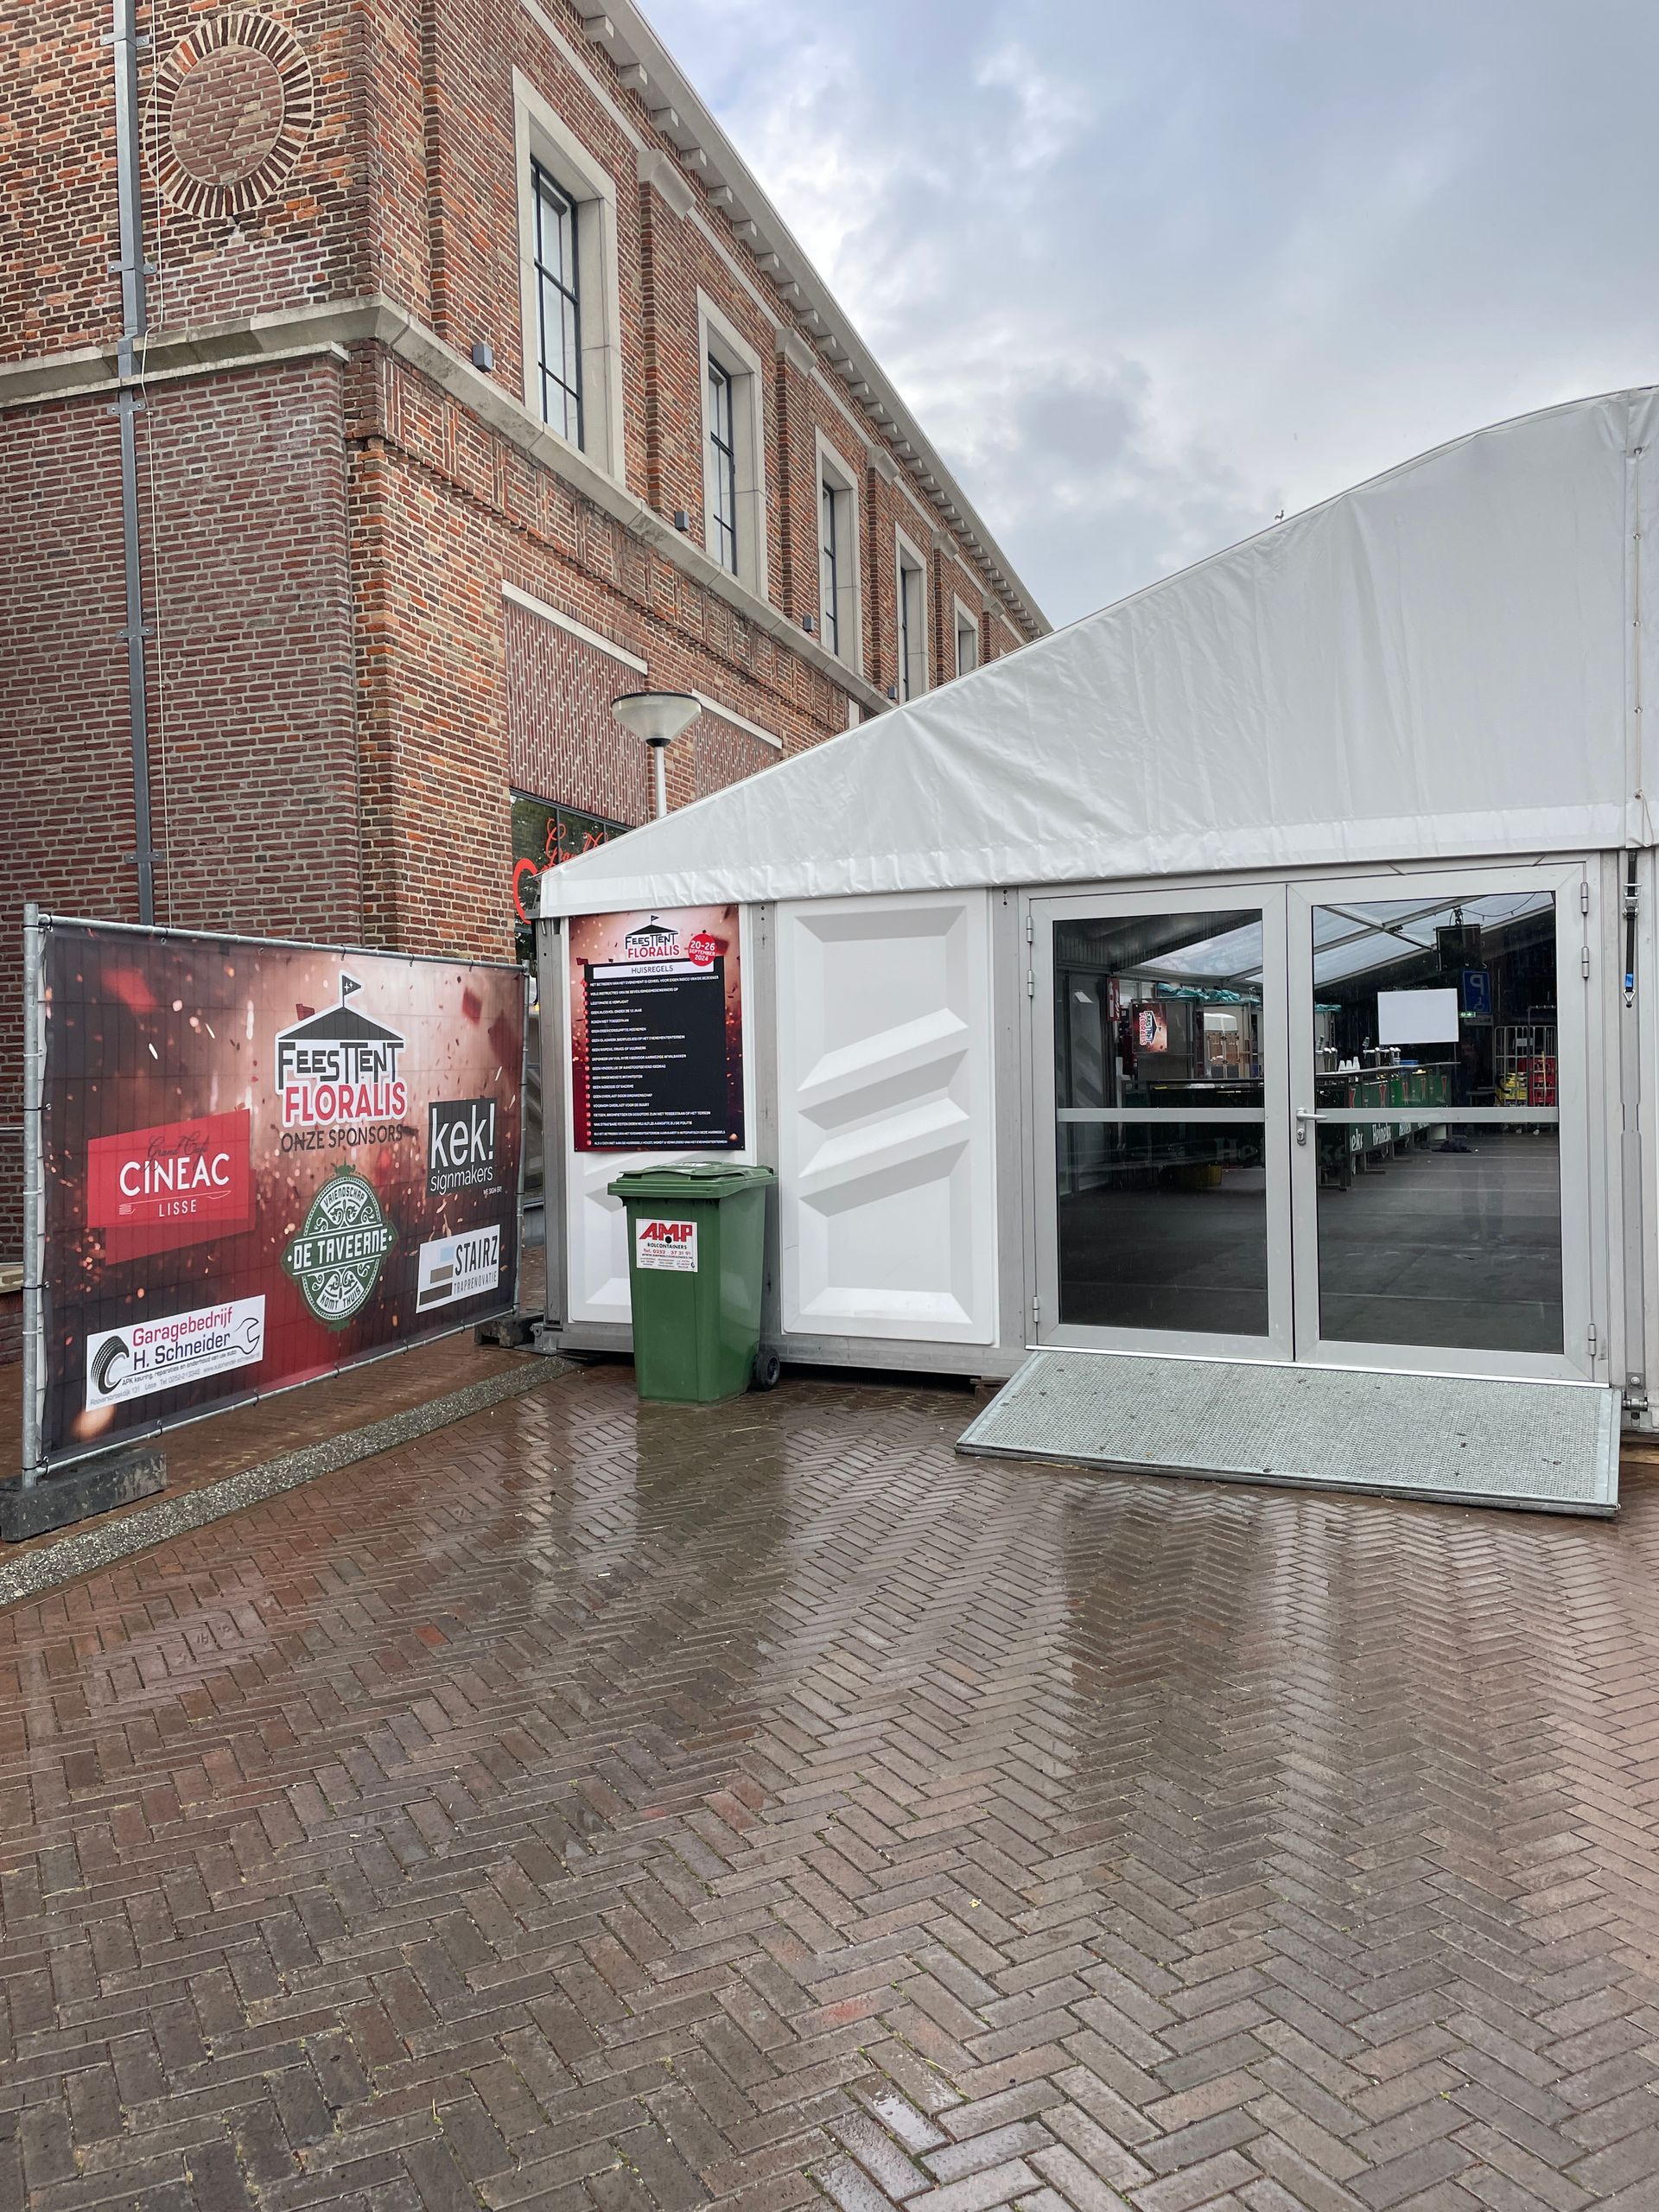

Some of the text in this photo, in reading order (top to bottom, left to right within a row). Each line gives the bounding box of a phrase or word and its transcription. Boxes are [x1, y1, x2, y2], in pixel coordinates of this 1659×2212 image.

[628, 944, 680, 958] FLORALIS
[691, 940, 715, 950] 20-26
[631, 965, 674, 974] HUISREGELS
[278, 1042, 404, 1090] FEESTTENT
[285, 1082, 405, 1123] FLORALIS
[281, 1124, 403, 1153] ONZE SPONSORS
[431, 1103, 495, 1169] kek!
[119, 1153, 230, 1197] CINEAC
[430, 1165, 493, 1196] signmakers
[159, 1199, 197, 1217] LISSE
[293, 1229, 388, 1270] DE TAVEERNE
[639, 1223, 693, 1242] AMP
[455, 1235, 498, 1276] STAIRZ
[454, 1271, 497, 1294] TRAPRENOVATIE
[132, 1306, 233, 1347] Garagebedrijf
[134, 1333, 230, 1370] H. Schneider
